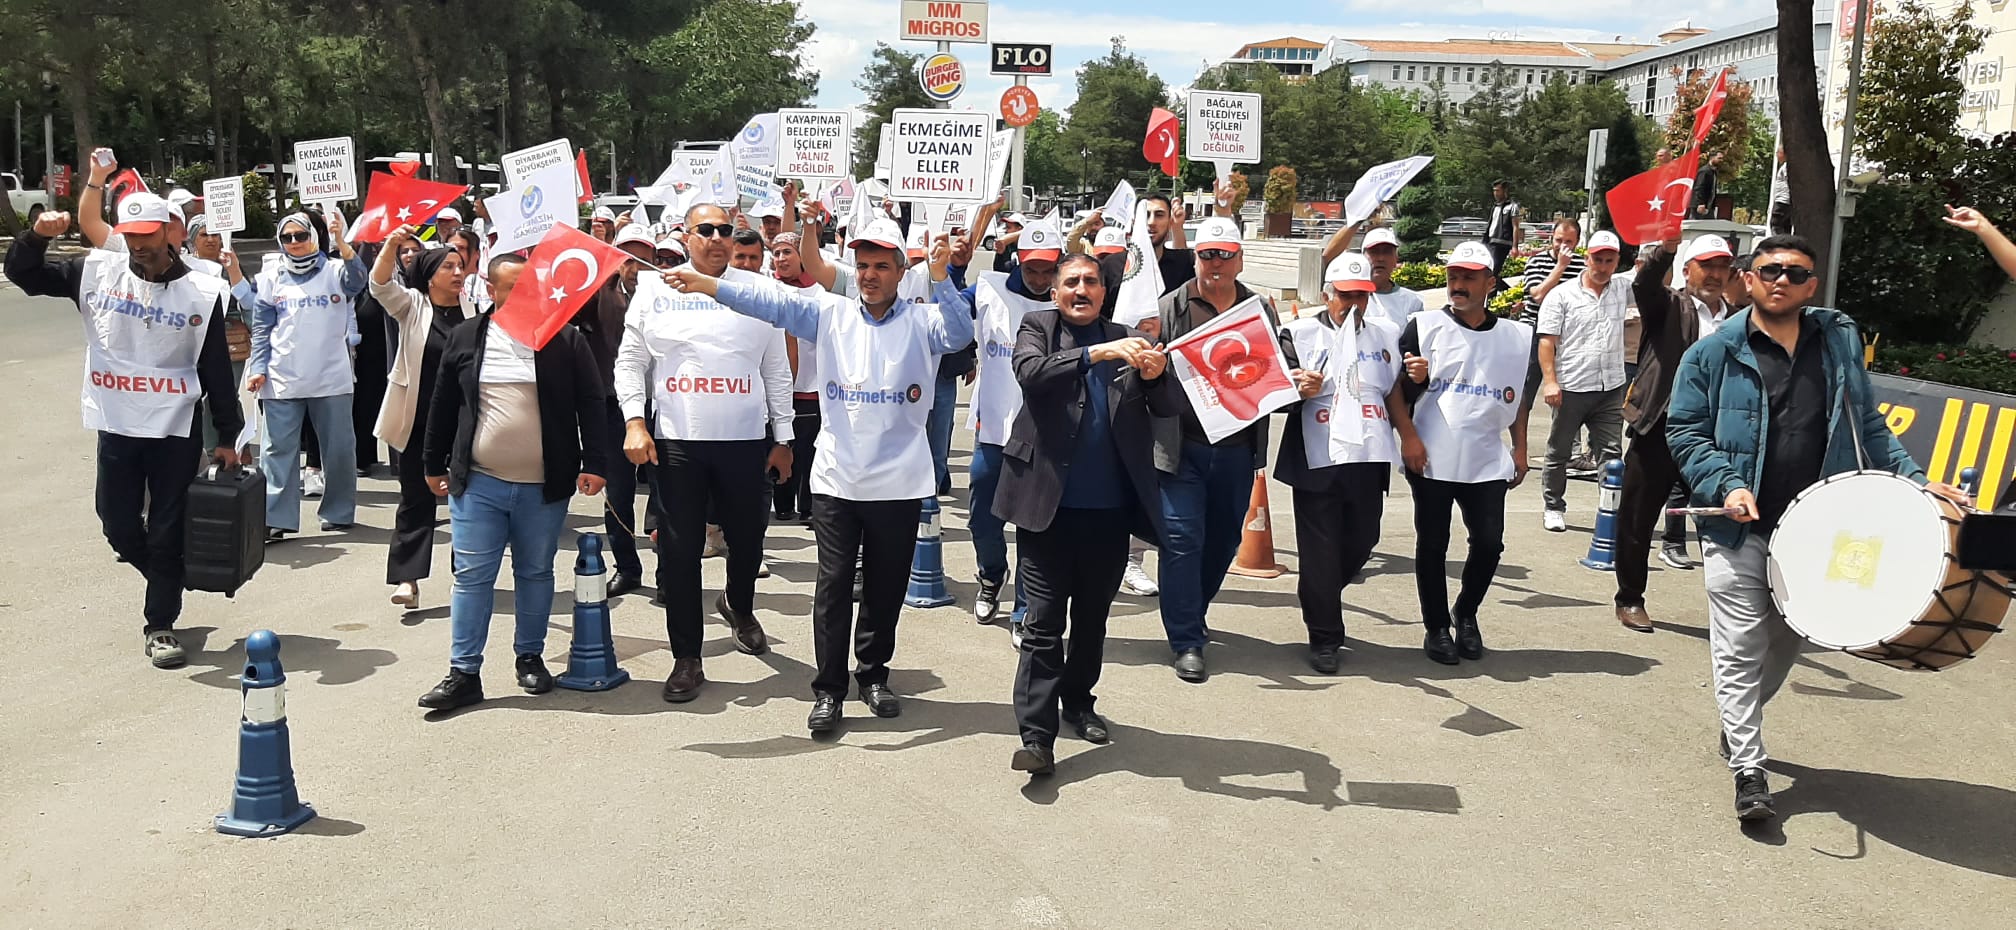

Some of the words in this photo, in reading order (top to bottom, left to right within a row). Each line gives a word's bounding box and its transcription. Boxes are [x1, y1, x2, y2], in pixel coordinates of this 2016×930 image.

[928, 2, 961, 18] MM
[908, 20, 980, 37] MiGROS
[997, 48, 1047, 66] FLO
[925, 62, 959, 78] BURGER
[926, 70, 960, 89] KING
[1207, 97, 1243, 109] BAĞLAR
[786, 115, 841, 125] KAYAPINAR
[1200, 109, 1249, 121] BELEDİYESİ
[787, 125, 840, 137] BELEDİYESİ
[899, 120, 983, 138] EKMEĞİME
[1207, 119, 1242, 132] İŞÇİLERİ
[1209, 132, 1240, 142] YALNIZ
[794, 138, 832, 150] İŞÇİLERİ
[908, 141, 972, 156] UZANAN
[1203, 142, 1245, 153] DEĞİLDİR
[299, 145, 347, 160] EKMEĞİME
[515, 148, 558, 166] DİYARBAKIR
[796, 152, 829, 161] YALNIZ
[305, 159, 342, 171] UZANAN
[789, 162, 834, 174] DEĞİLDİR
[917, 160, 959, 173] ELLER
[312, 172, 337, 182] ELLER
[306, 184, 341, 195] KIRILSIN
[902, 177, 963, 191] KIRILSIN
[969, 178, 974, 192] !
[91, 371, 187, 394] GÖREVLİ
[666, 373, 752, 394] GÖREVLİ
[838, 385, 905, 405] hizmet-iş
